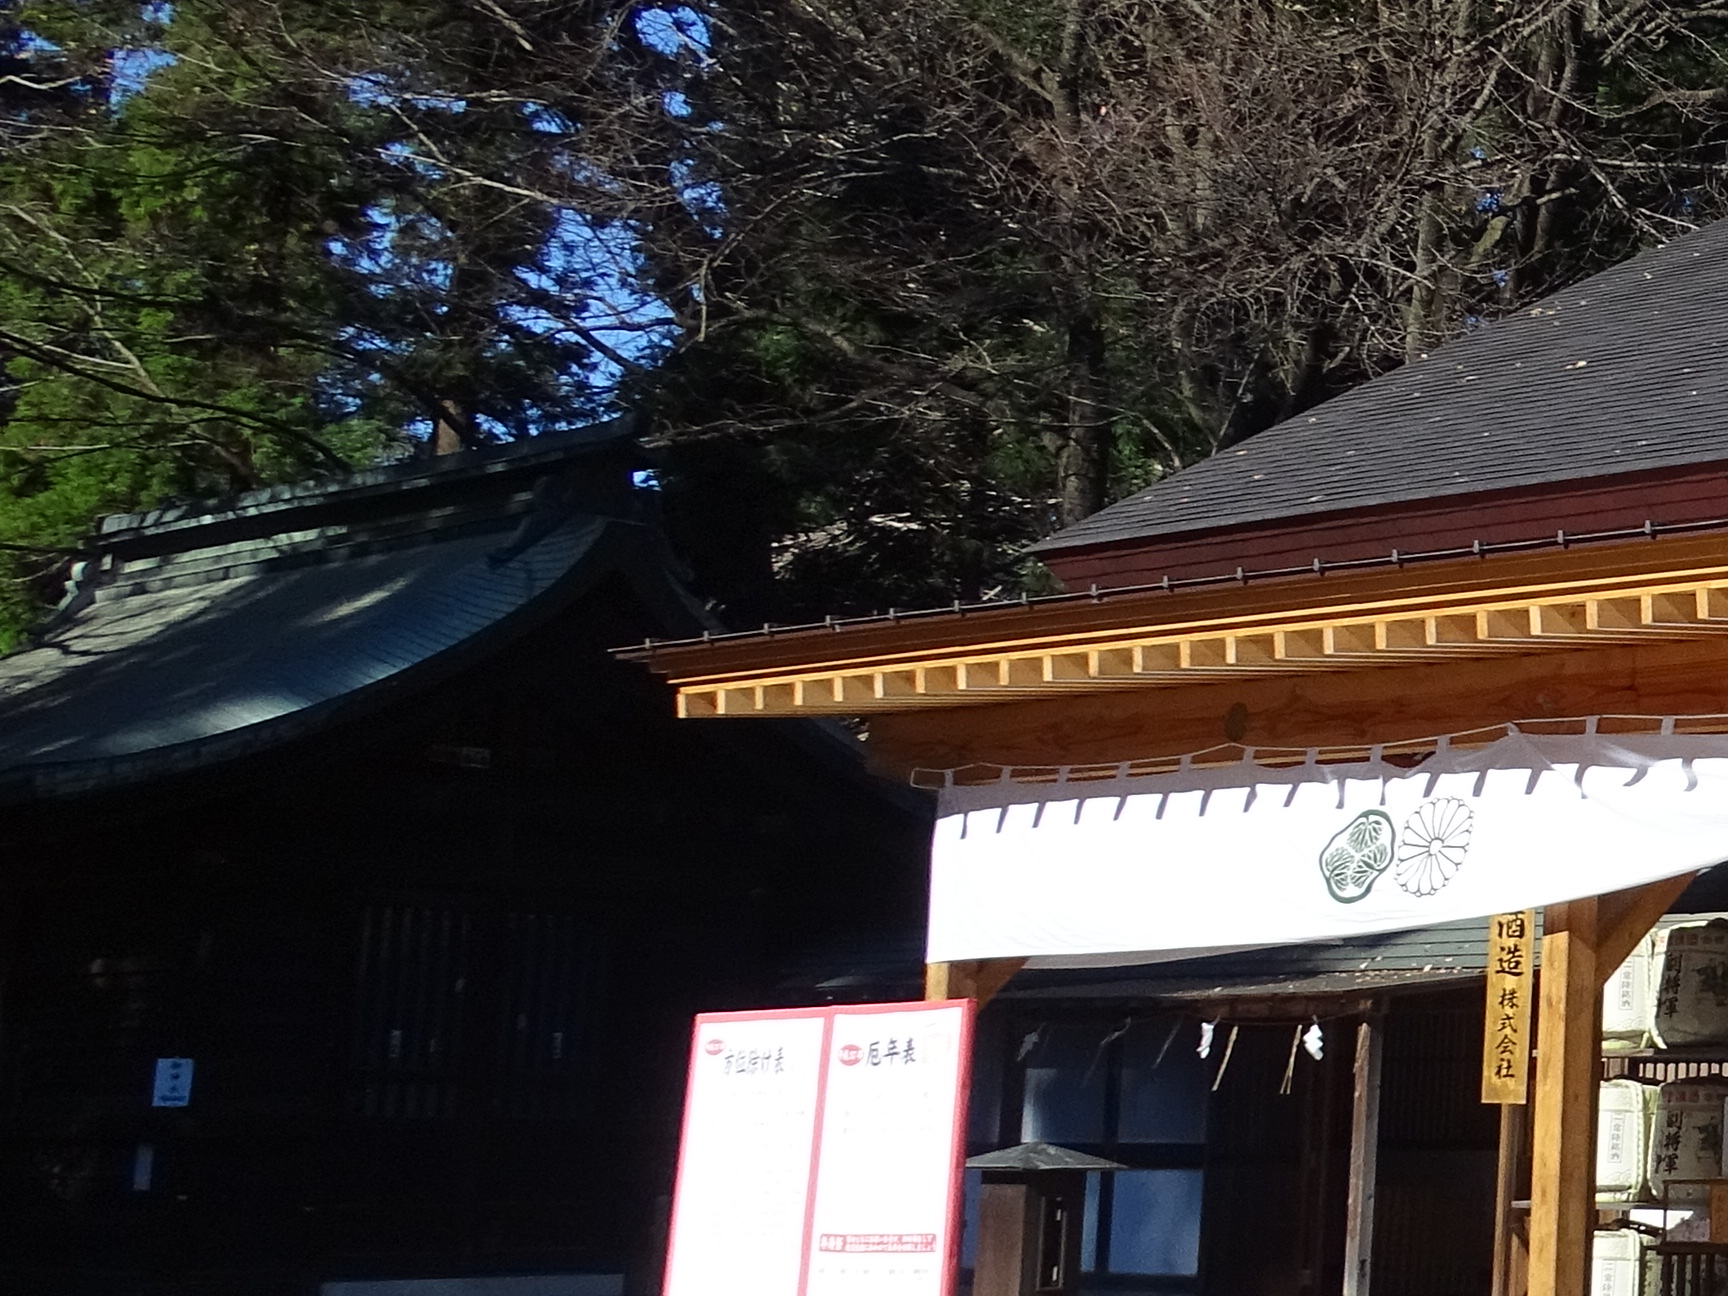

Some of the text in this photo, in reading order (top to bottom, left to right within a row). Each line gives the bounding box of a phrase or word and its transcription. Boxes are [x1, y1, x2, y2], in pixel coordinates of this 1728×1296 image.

[865, 1036, 918, 1068] 厄年表
[1494, 986, 1520, 1080] 株式会社
